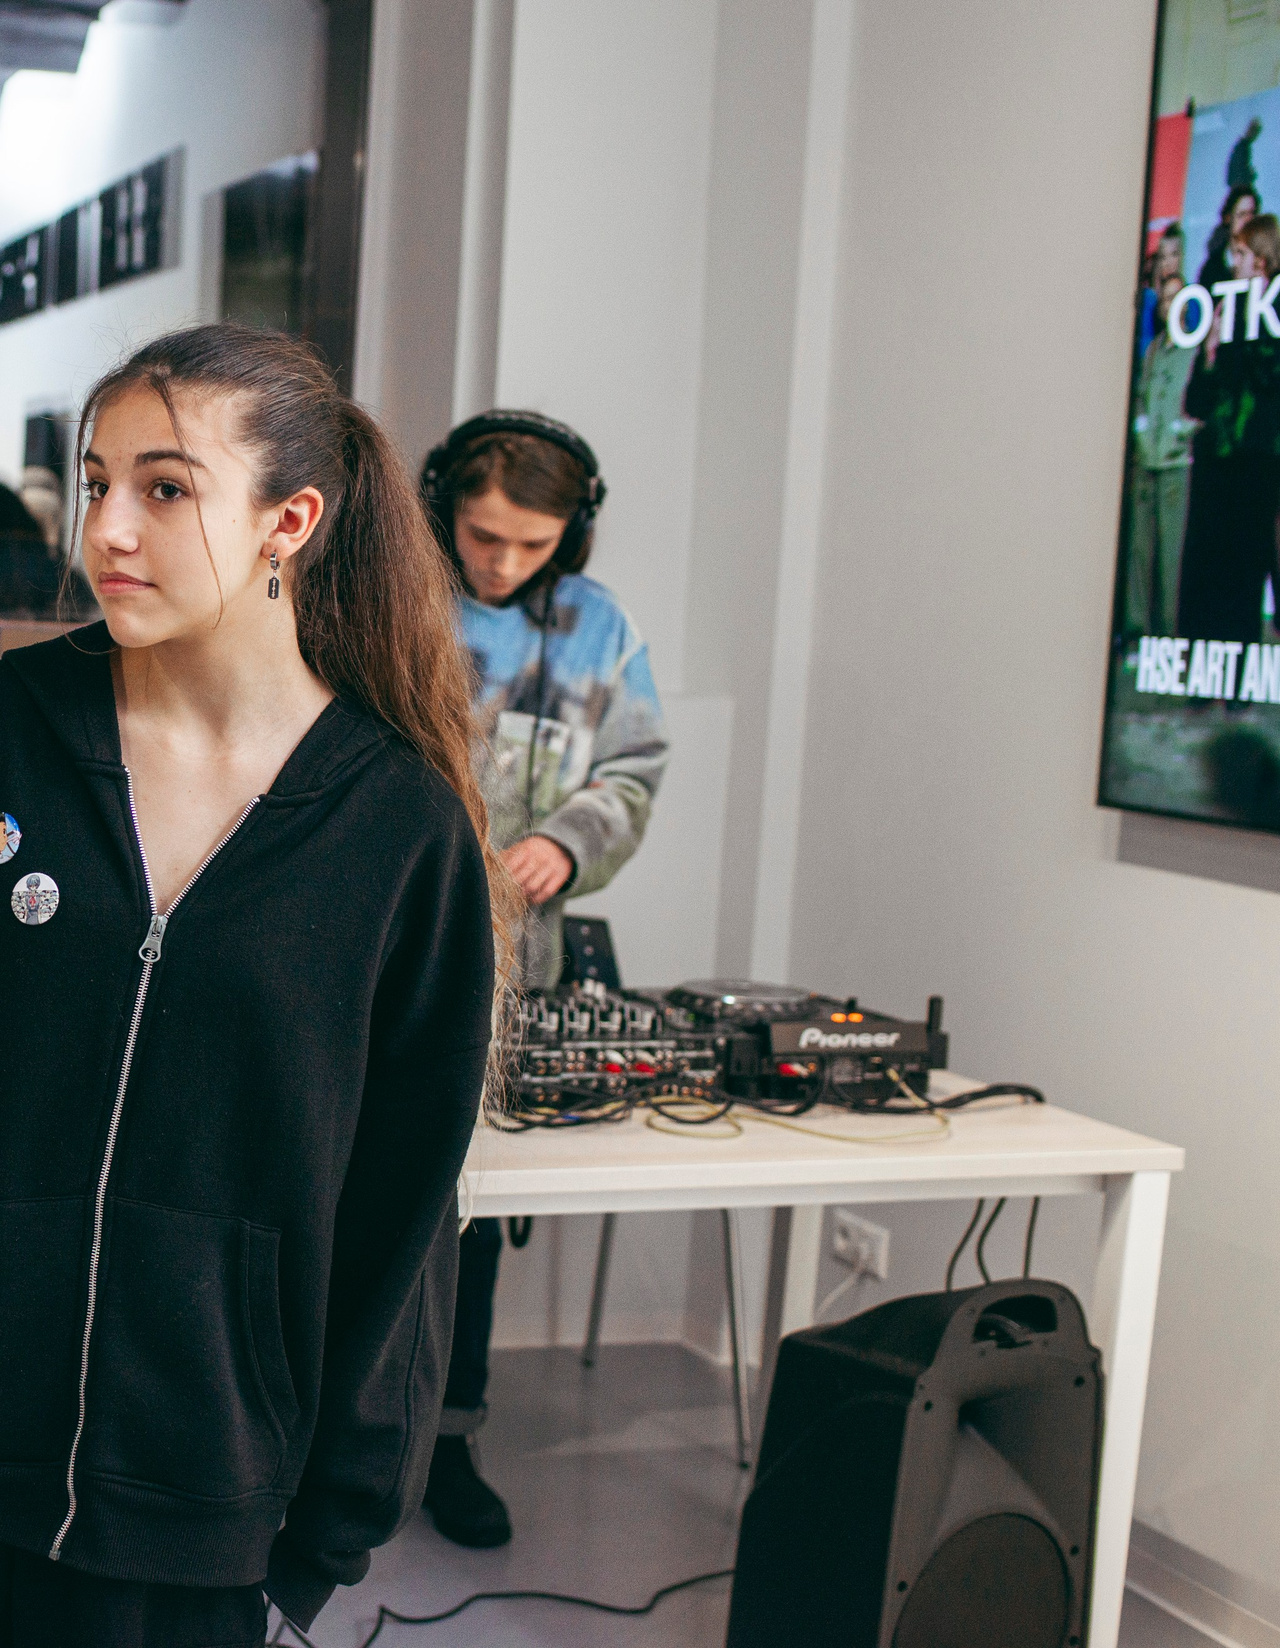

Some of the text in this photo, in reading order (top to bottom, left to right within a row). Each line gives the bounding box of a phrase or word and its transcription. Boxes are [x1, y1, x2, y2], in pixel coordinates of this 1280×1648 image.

[1136, 635, 1189, 695] HSE
[1187, 639, 1243, 699] ART
[799, 1027, 900, 1049] Pioneer
